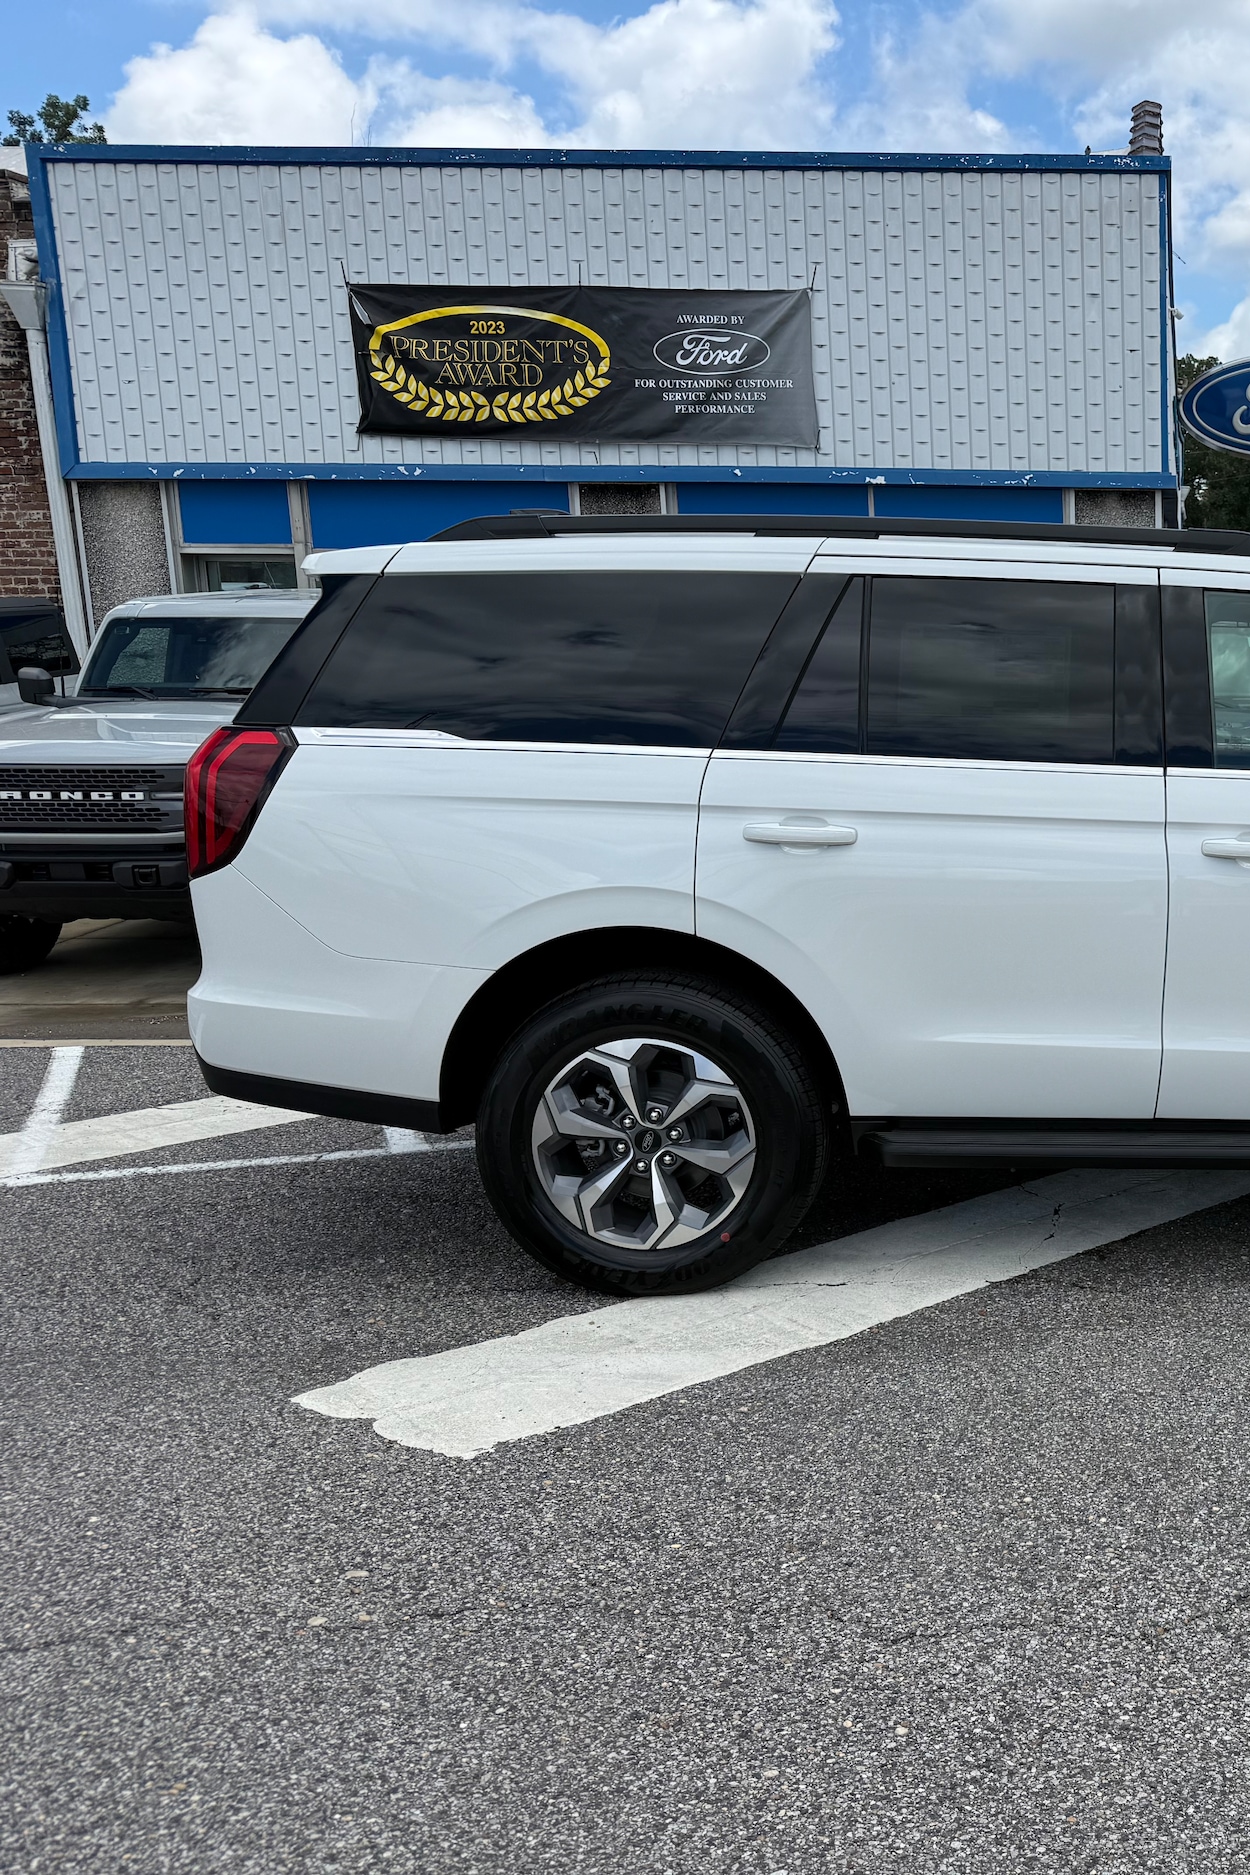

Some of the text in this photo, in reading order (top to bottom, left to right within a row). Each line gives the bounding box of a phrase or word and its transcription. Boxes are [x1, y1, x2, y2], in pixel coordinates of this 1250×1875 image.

[676, 315, 745, 325] AWARDED BY
[469, 320, 506, 335] 2023
[388, 335, 591, 364] PRESIDENT'S
[675, 334, 749, 366] Ford
[434, 362, 544, 388] AWARD
[634, 378, 794, 389] FOR OUTSTANDING CUSTOMER
[662, 391, 767, 401] SERVICE AND SALES
[674, 404, 756, 414] PERFORMANCE
